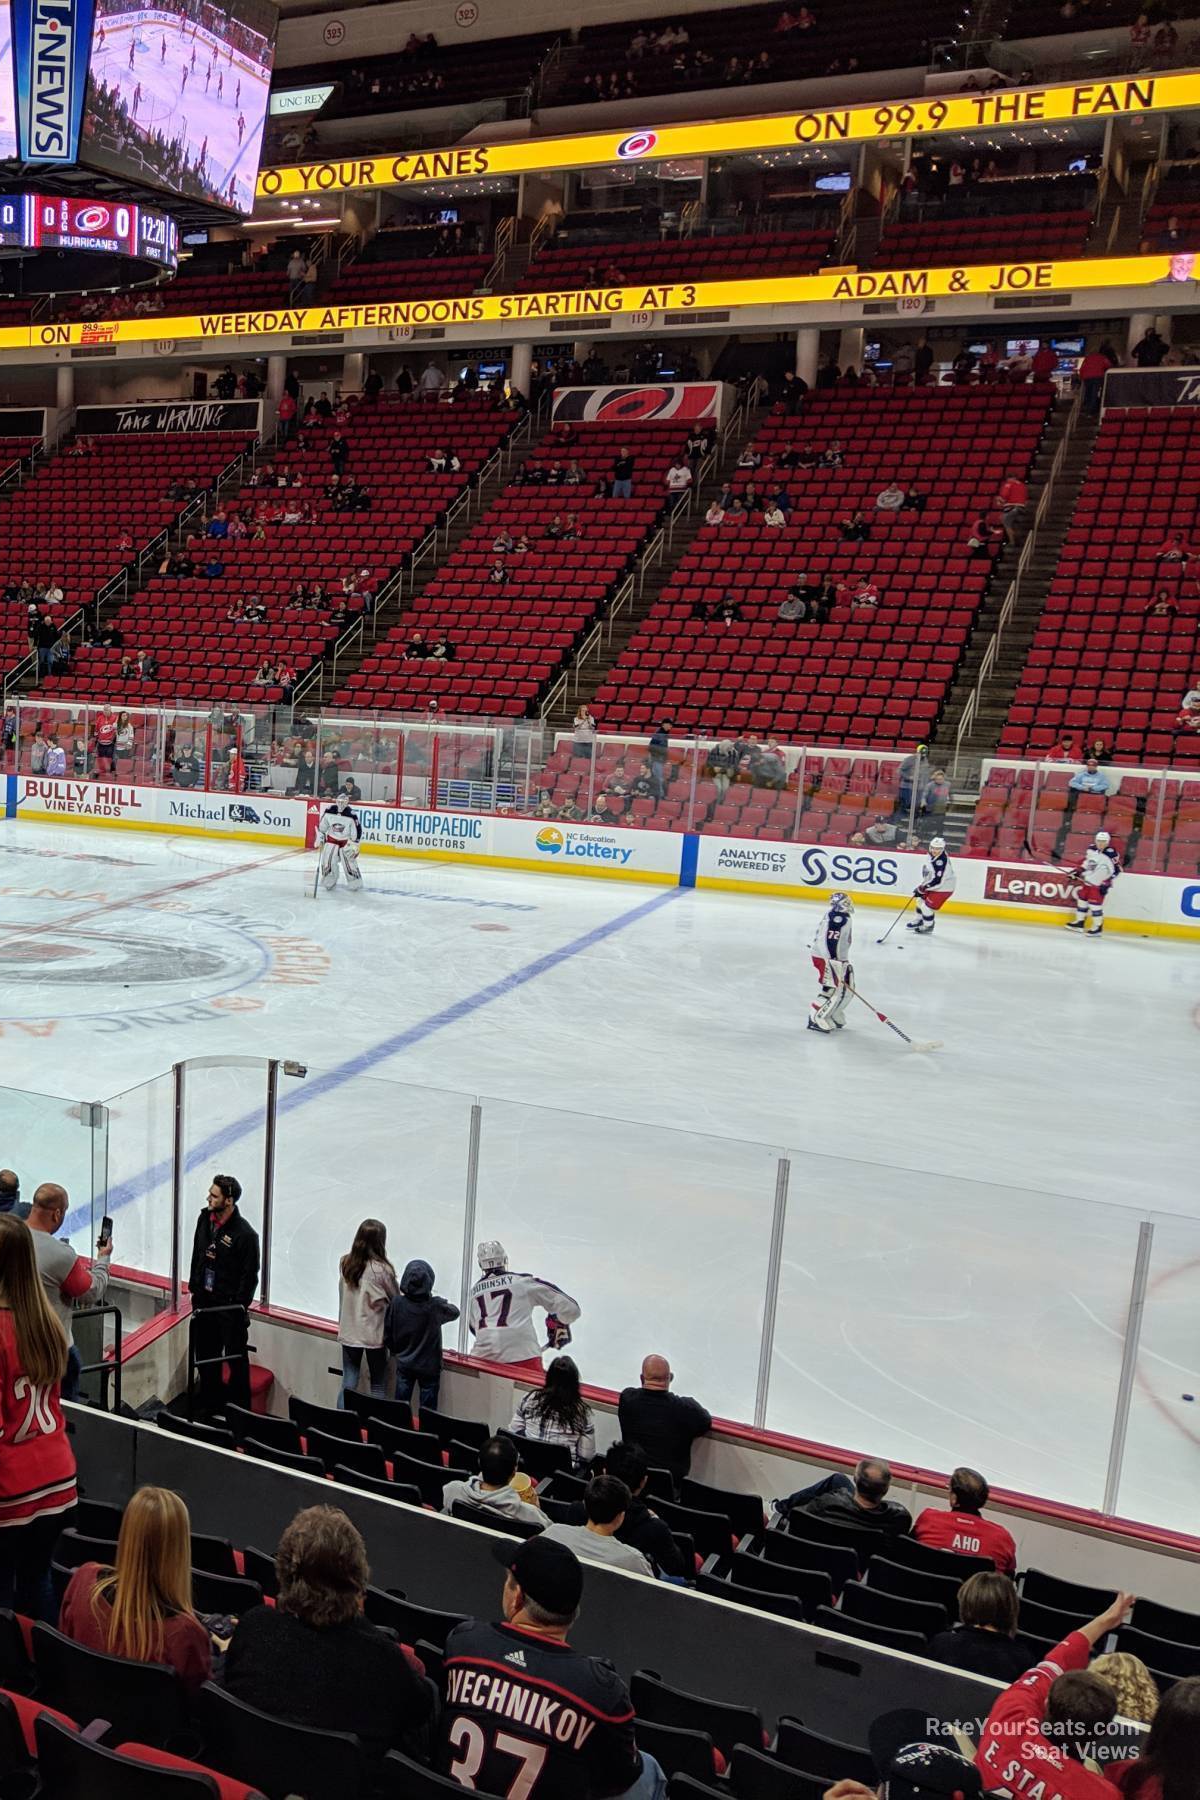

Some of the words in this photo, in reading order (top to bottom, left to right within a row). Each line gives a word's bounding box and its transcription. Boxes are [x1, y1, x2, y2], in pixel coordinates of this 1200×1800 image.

[35, 33, 66, 153] NEWS
[279, 96, 302, 108] UNC
[304, 93, 325, 106] REX
[795, 111, 849, 143] ON
[874, 101, 949, 135] 99.9
[971, 91, 1046, 125] THE
[1071, 79, 1155, 115] FAN
[299, 161, 375, 191] YOUR
[393, 147, 489, 182] CANES
[3, 205, 14, 225] 0
[44, 206, 55, 226] 0
[116, 208, 129, 238] 0
[141, 215, 165, 245] 12:20
[59, 236, 118, 251] HURRICANES
[145, 246, 161, 257] FIRST
[833, 272, 928, 299] ADAM
[949, 270, 970, 293] &
[989, 265, 1052, 291] JOE
[200, 310, 307, 335] WEEKDAY
[320, 300, 483, 329] AFTERNOONS
[500, 290, 623, 319] STARTING
[641, 288, 674, 308] AT
[681, 286, 696, 307] 3
[901, 298, 921, 311] 120
[631, 312, 648, 325] 119
[41, 326, 71, 344] ON
[395, 326, 410, 337] 118
[160, 340, 172, 351] 117
[156, 403, 228, 433] WARNING
[25, 780, 89, 800] BULLY
[96, 787, 142, 807] HILL
[44, 800, 122, 817] VINEYARDS
[169, 801, 225, 821] Michael
[263, 810, 291, 827] Son
[386, 812, 482, 839] ORTHOPAEDIC
[386, 834, 413, 845] TEAM
[417, 837, 465, 850] DOCTORS
[566, 832, 578, 840] NC
[580, 834, 616, 844] Education
[565, 841, 632, 864] Lottery
[720, 848, 786, 863] ANALYTICS
[718, 859, 770, 871] POWERED
[772, 864, 786, 873] BY
[828, 930, 840, 940] 72
[476, 1289, 513, 1330] 17
[13, 1375, 57, 1444] 20
[952, 1533, 980, 1553] AHO
[450, 1717, 548, 1800] 37
